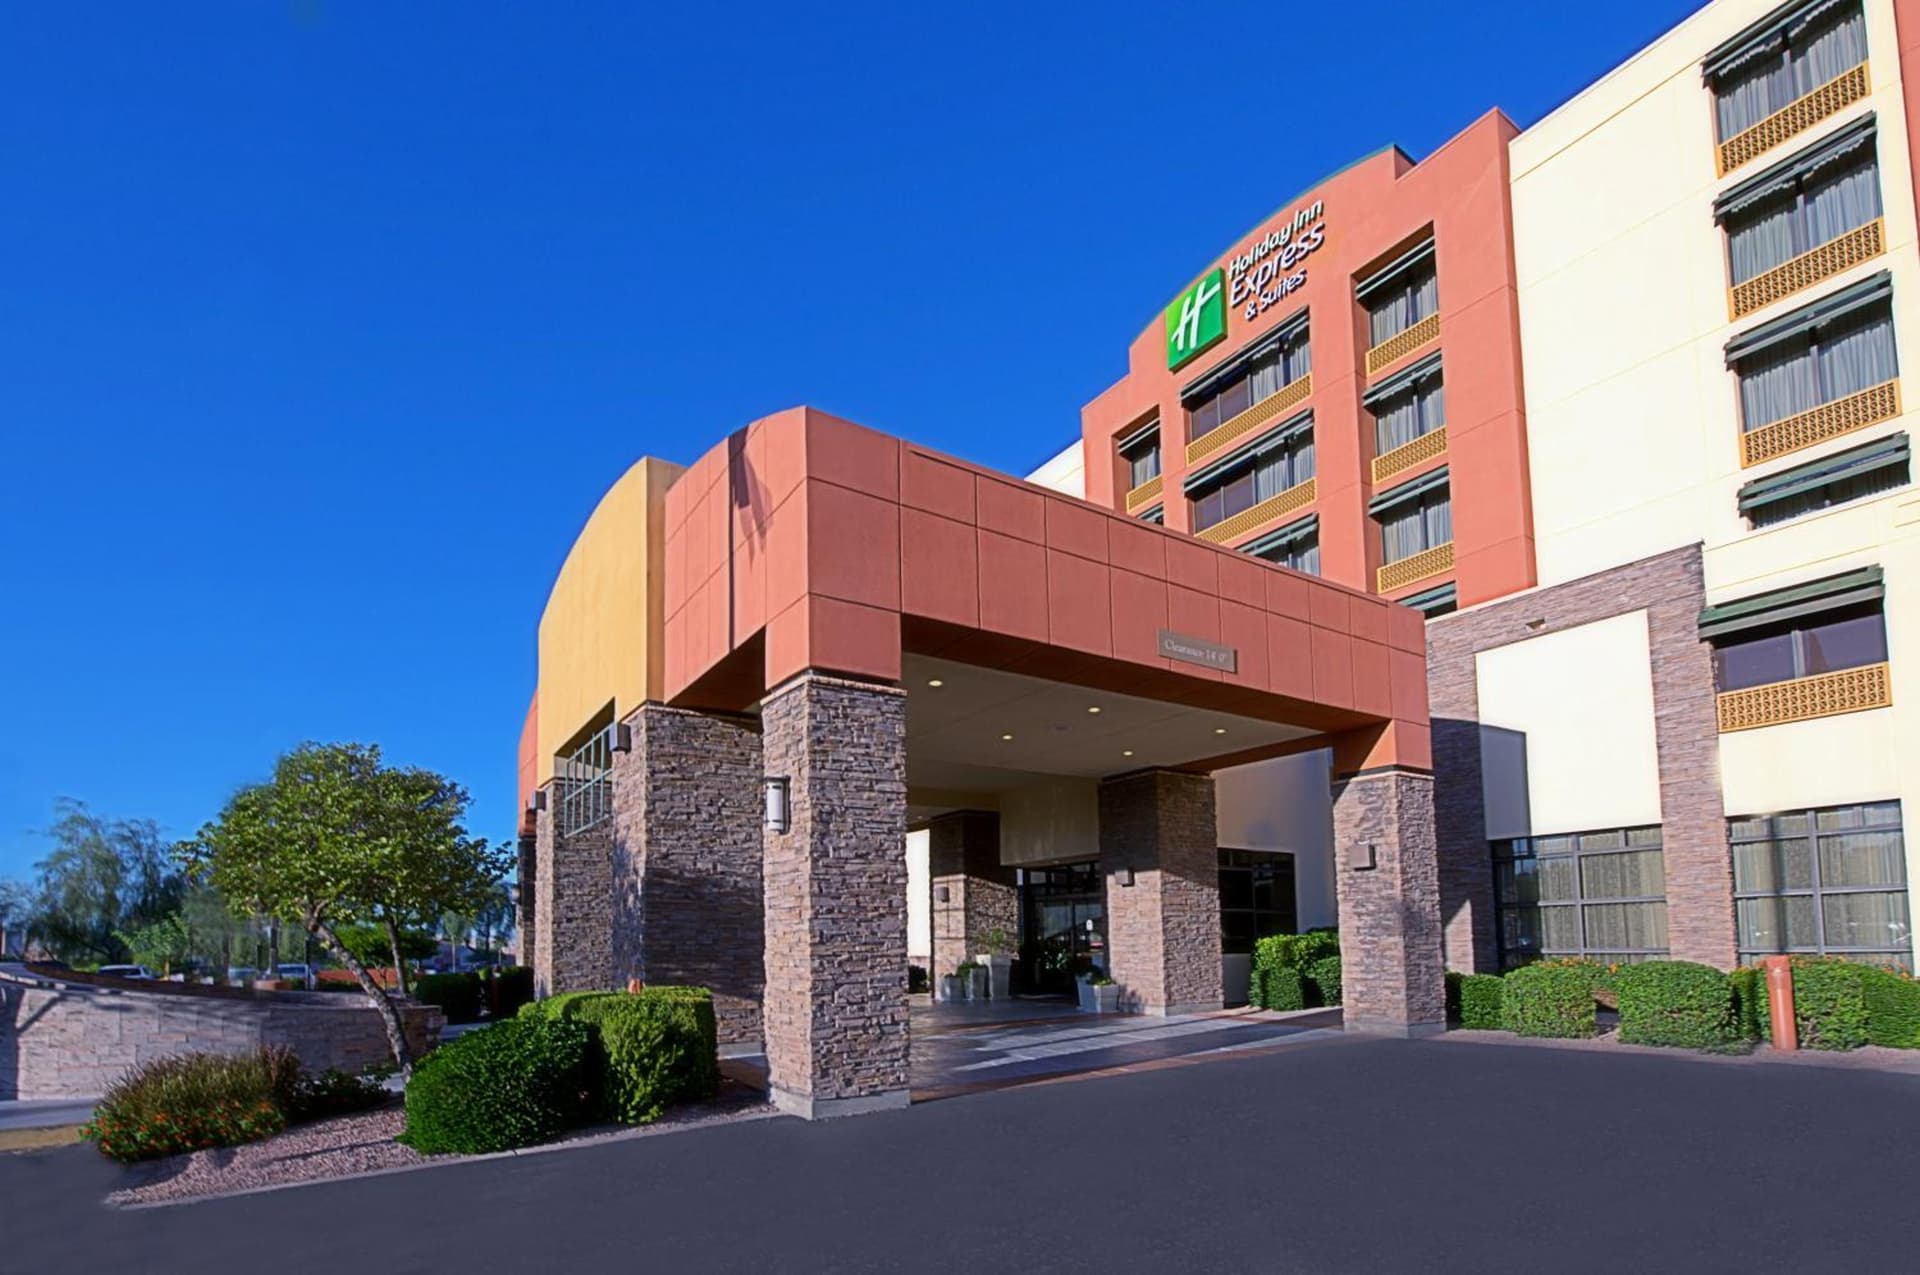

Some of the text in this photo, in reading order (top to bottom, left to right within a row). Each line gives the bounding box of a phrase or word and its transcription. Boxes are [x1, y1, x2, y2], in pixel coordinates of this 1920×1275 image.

[1228, 200, 1323, 279] Holiday Inn
[1231, 222, 1324, 306] Express
[1171, 281, 1221, 351] H
[1245, 269, 1306, 320] & Suites
